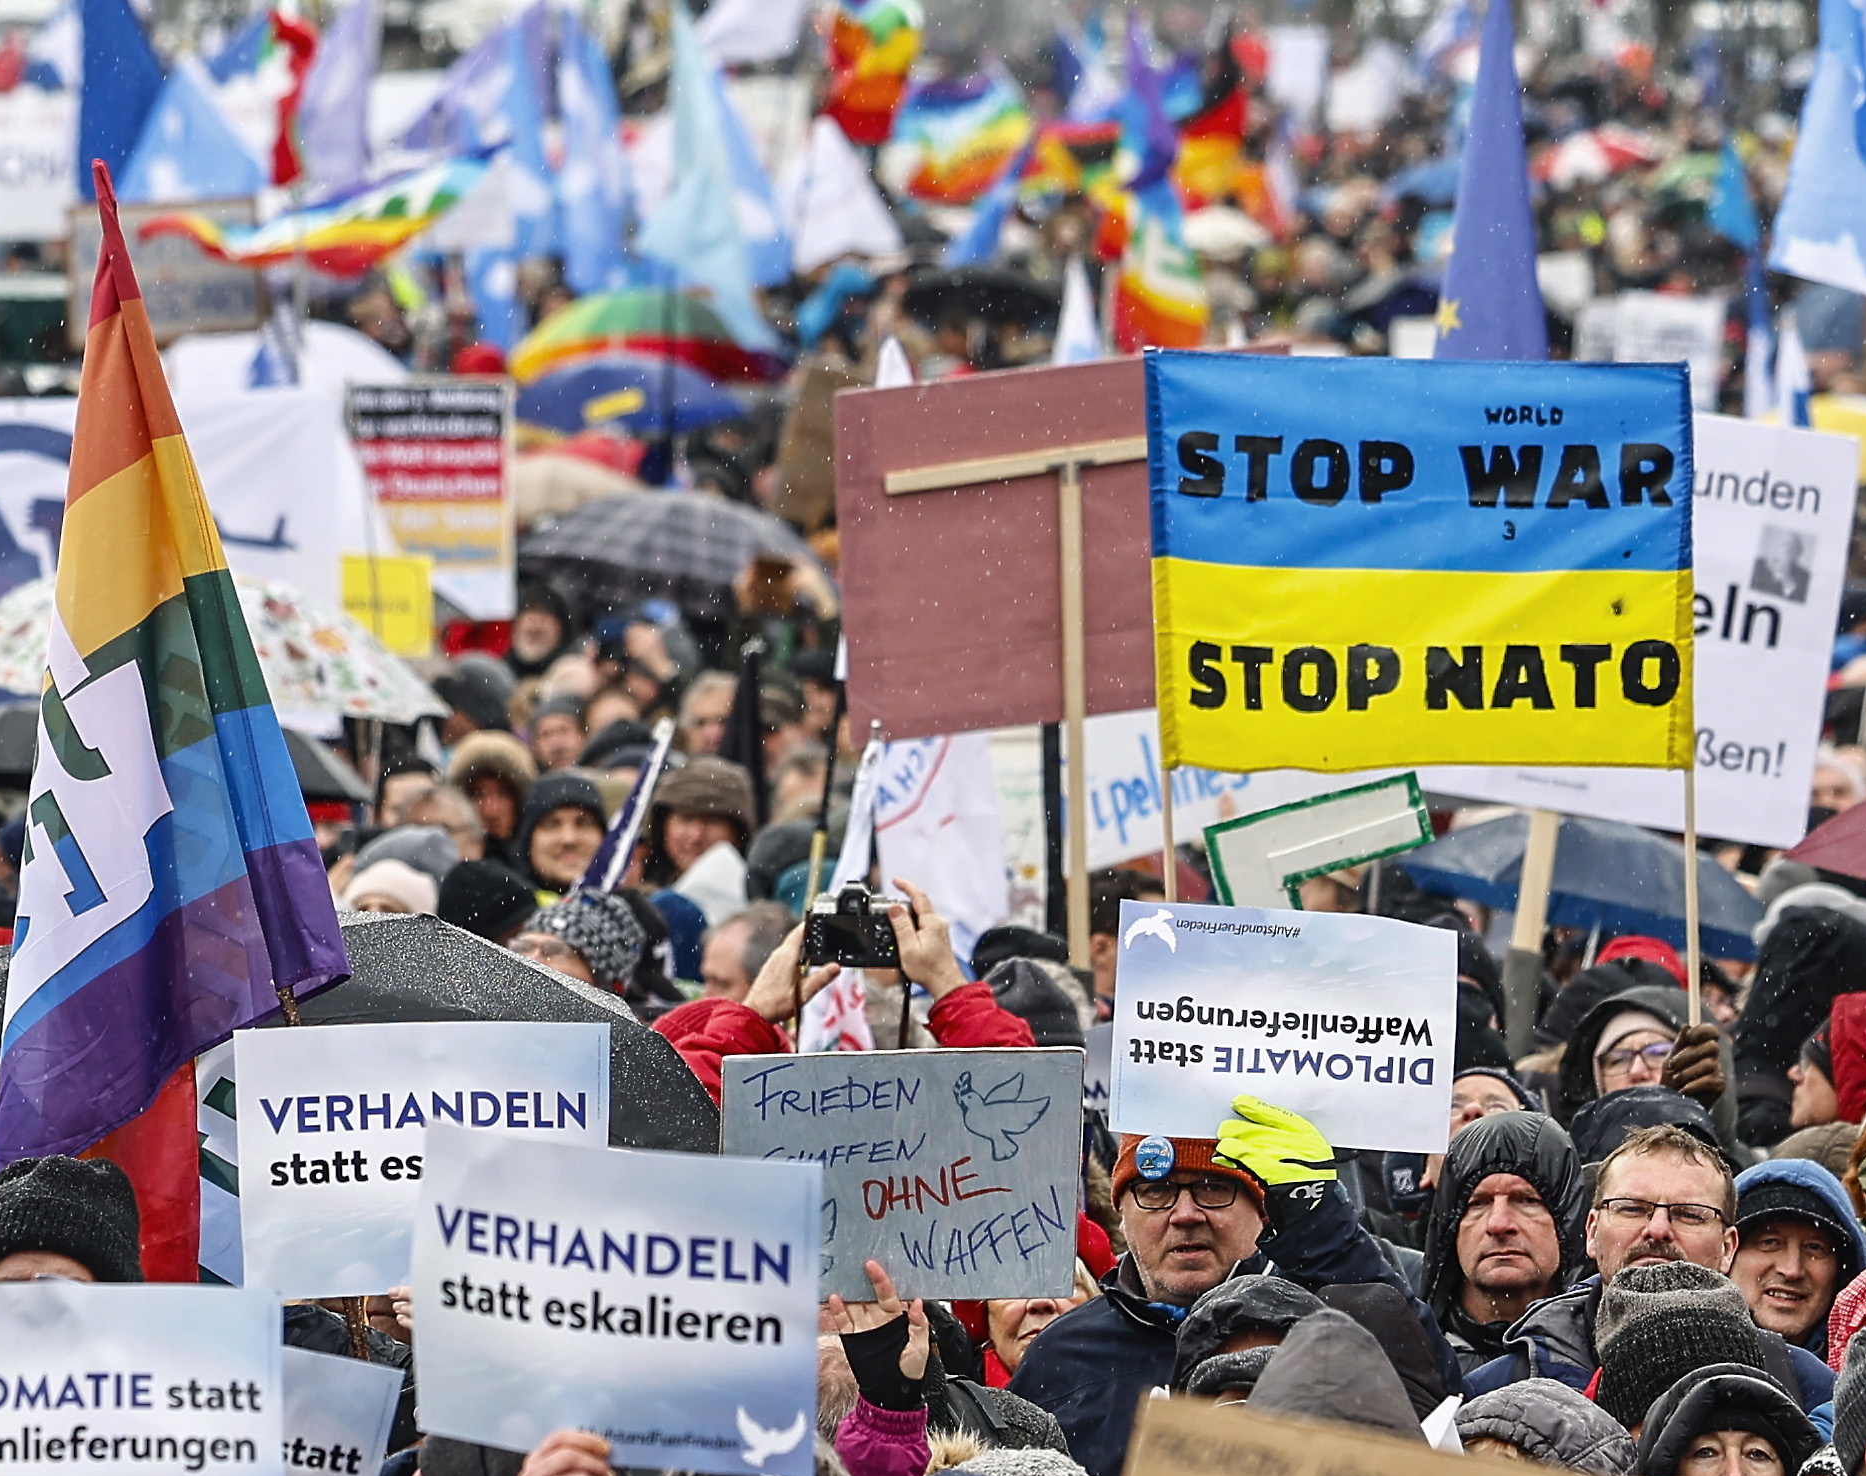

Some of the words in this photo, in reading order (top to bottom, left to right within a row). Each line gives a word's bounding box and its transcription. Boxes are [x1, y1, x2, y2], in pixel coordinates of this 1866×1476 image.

[1484, 406, 1564, 427] WORLD
[1176, 430, 1414, 507] STOP
[1459, 443, 1675, 509] WAR
[1187, 640, 1400, 713] STOP
[1424, 639, 1681, 712] NATO
[1137, 997, 1433, 1047] Waffenlieferungen
[1129, 1037, 1205, 1068] statt
[1213, 1044, 1434, 1086] DIPLOMATIE
[260, 1091, 587, 1136] VERHANDELN
[742, 1061, 921, 1121] FRIEDEN
[270, 1148, 356, 1188] statt
[863, 1157, 1012, 1221] OHNE
[436, 1204, 792, 1286] VERHANDELN
[901, 1185, 1068, 1275] WAFFEN
[440, 1274, 532, 1319] statt
[543, 1293, 784, 1347] eskalieren
[166, 1379, 262, 1415] statt
